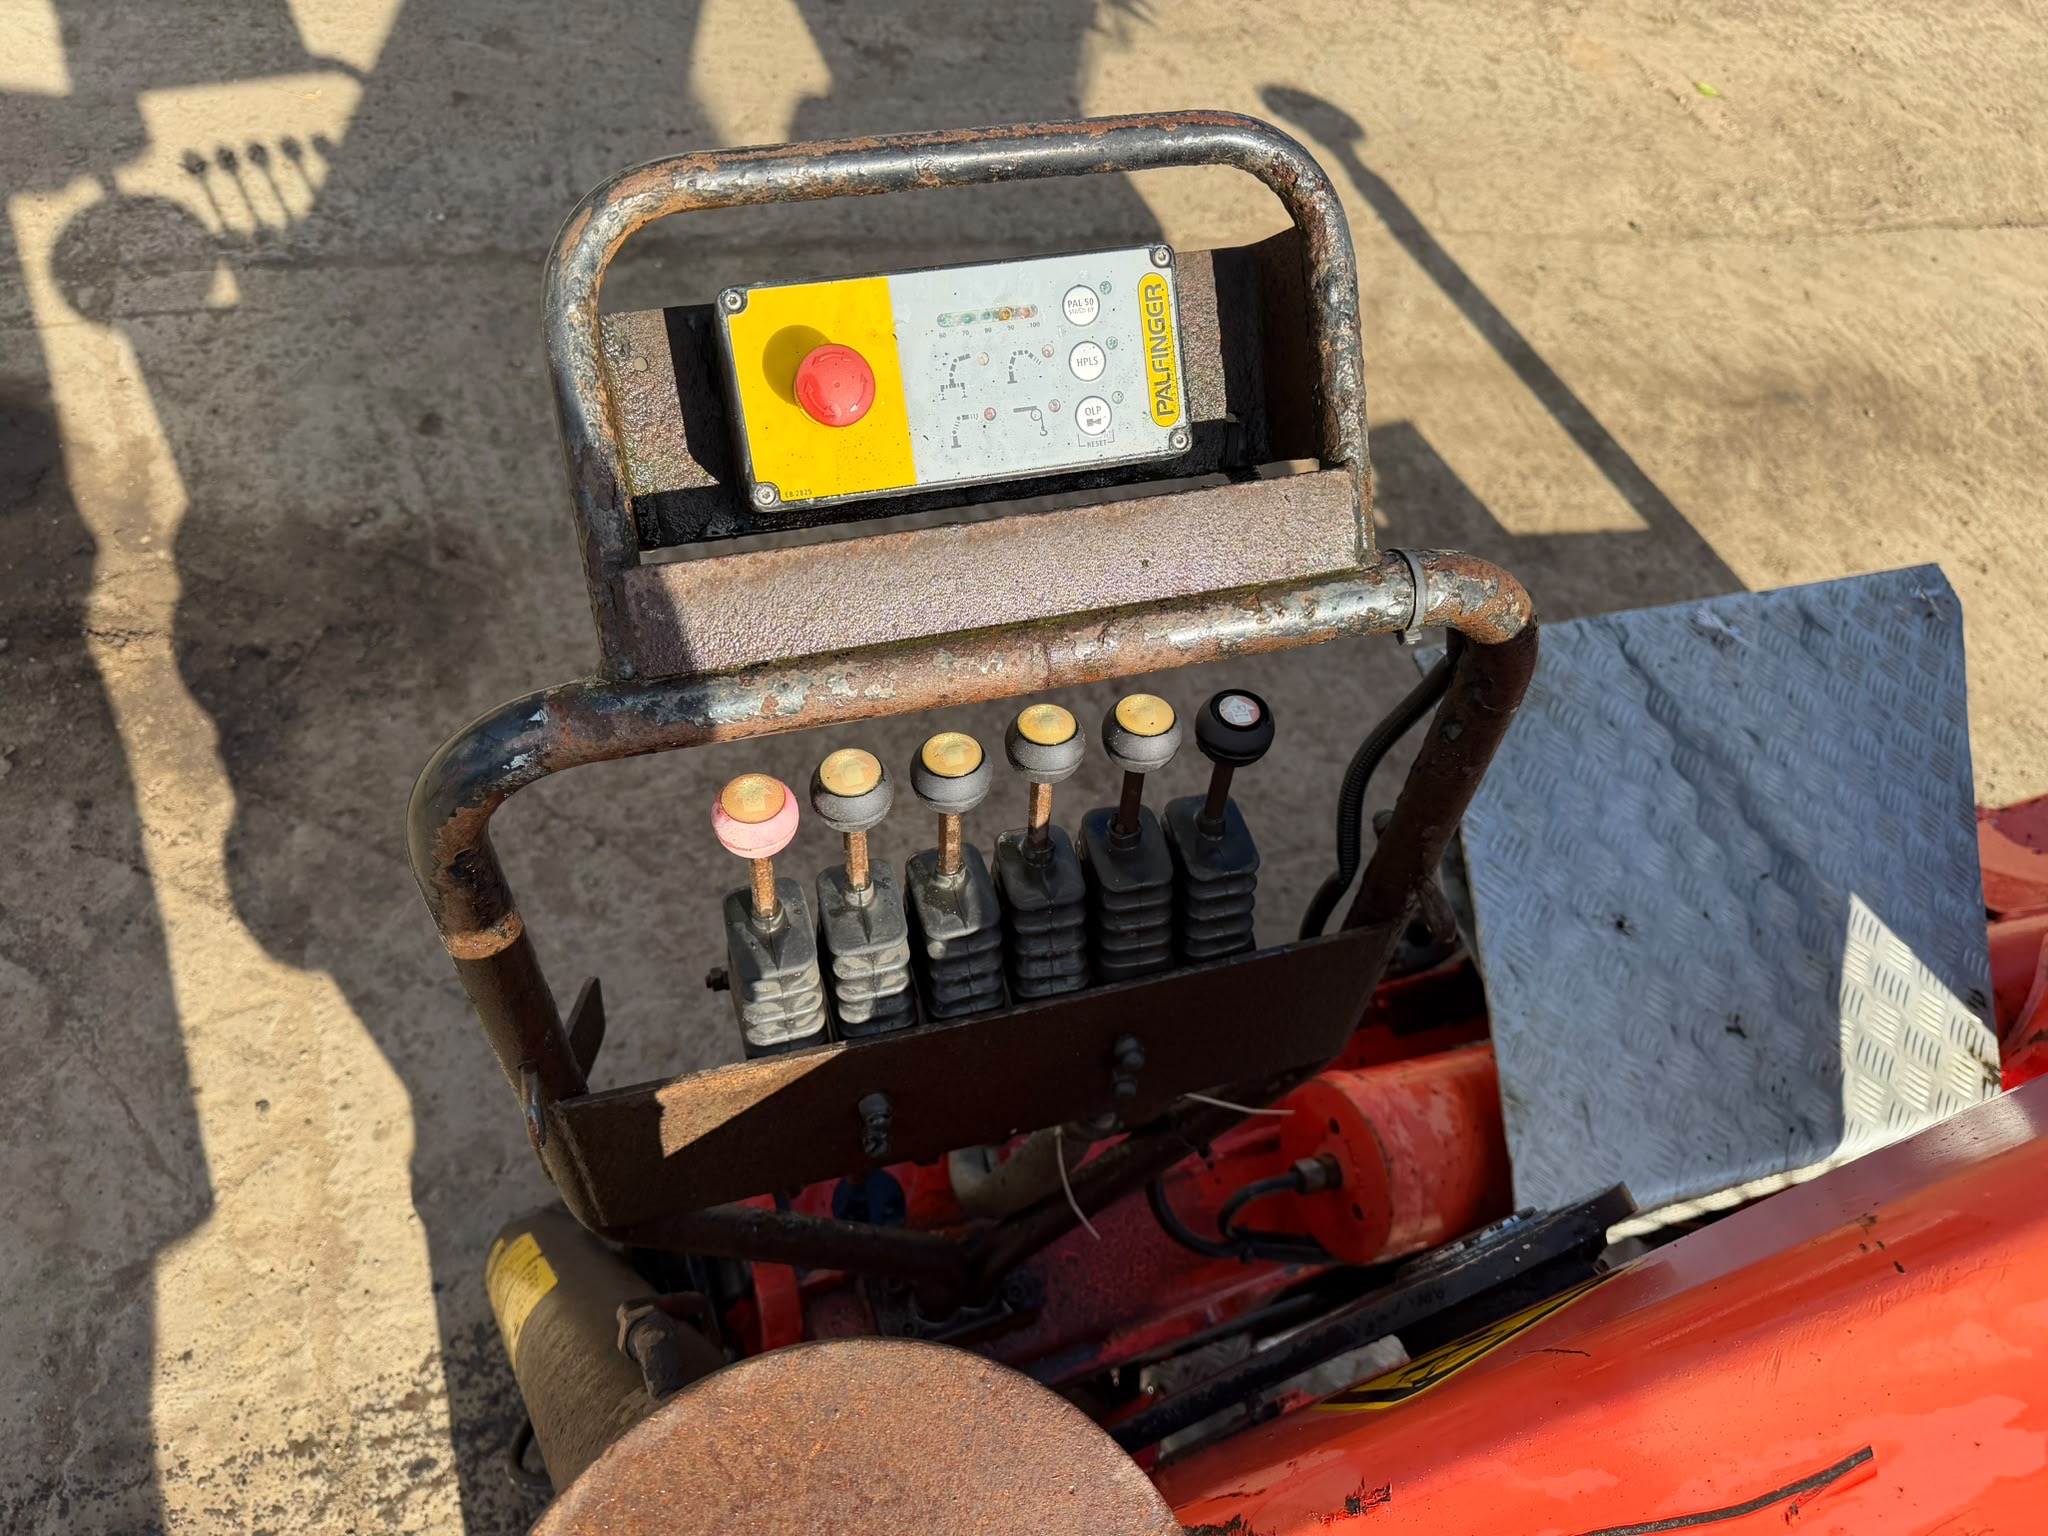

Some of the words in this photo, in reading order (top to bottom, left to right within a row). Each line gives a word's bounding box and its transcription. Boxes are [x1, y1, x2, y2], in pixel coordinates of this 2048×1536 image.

[1067, 298, 1083, 308] PAL
[1084, 297, 1094, 306] 50
[1144, 283, 1176, 417] PALFINGER
[1076, 356, 1099, 367] HPLS
[1084, 405, 1102, 416] OLP
[1087, 439, 1107, 448] RESET
